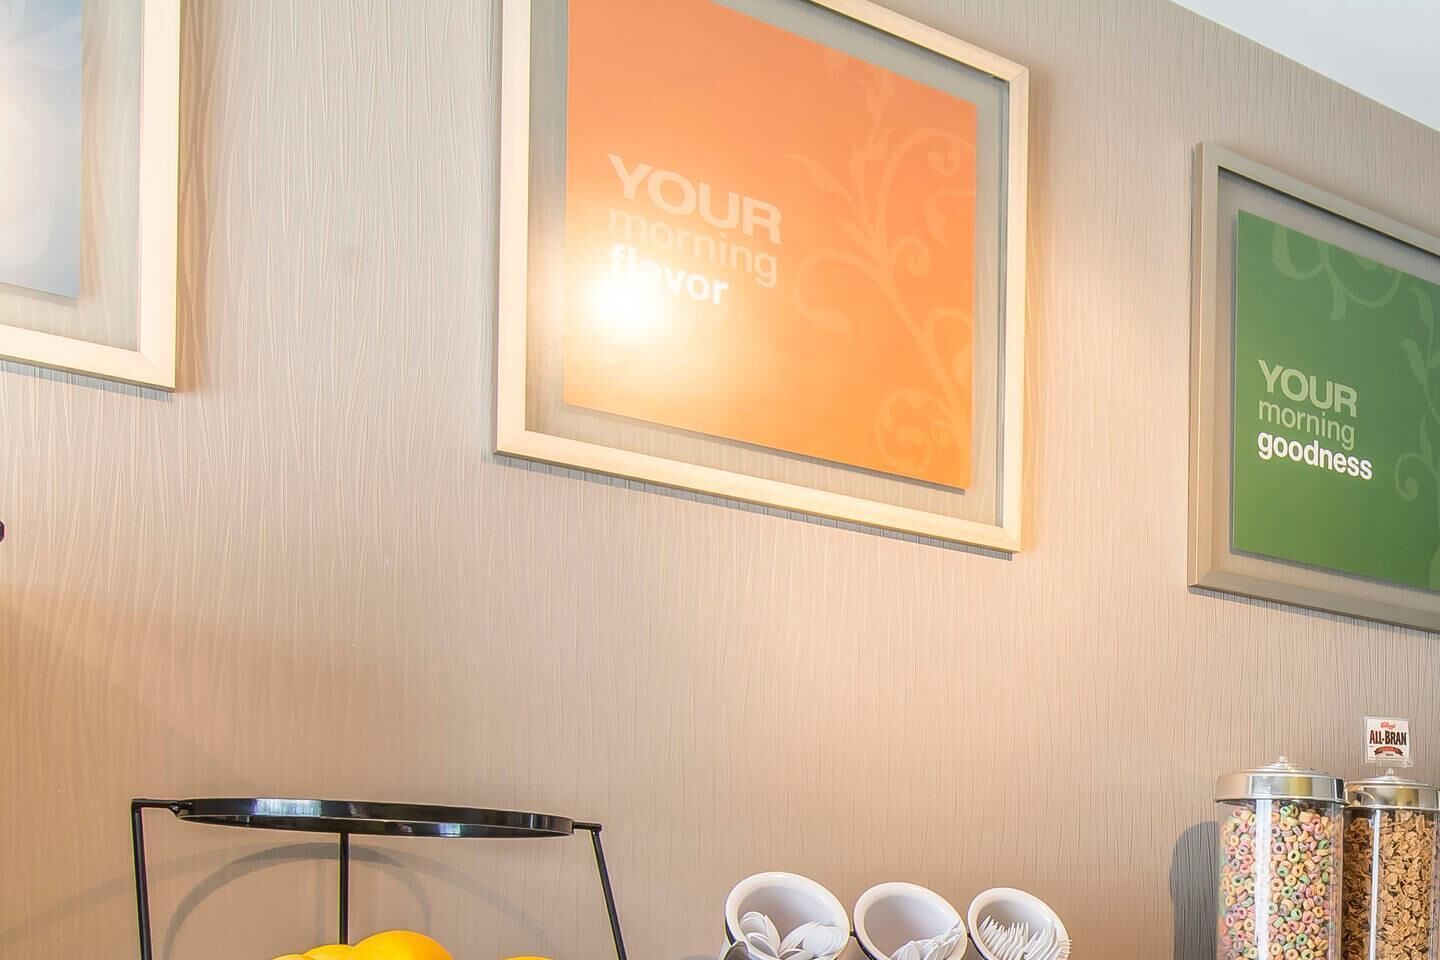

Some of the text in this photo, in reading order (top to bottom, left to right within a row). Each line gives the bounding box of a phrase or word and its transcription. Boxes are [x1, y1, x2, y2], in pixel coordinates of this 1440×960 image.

[606, 152, 782, 245] YOUR
[608, 208, 777, 288] morning
[609, 242, 729, 305] flavor
[1258, 359, 1358, 418] YOUR
[1257, 432, 1373, 480] goodness
[1258, 400, 1355, 451] morning
